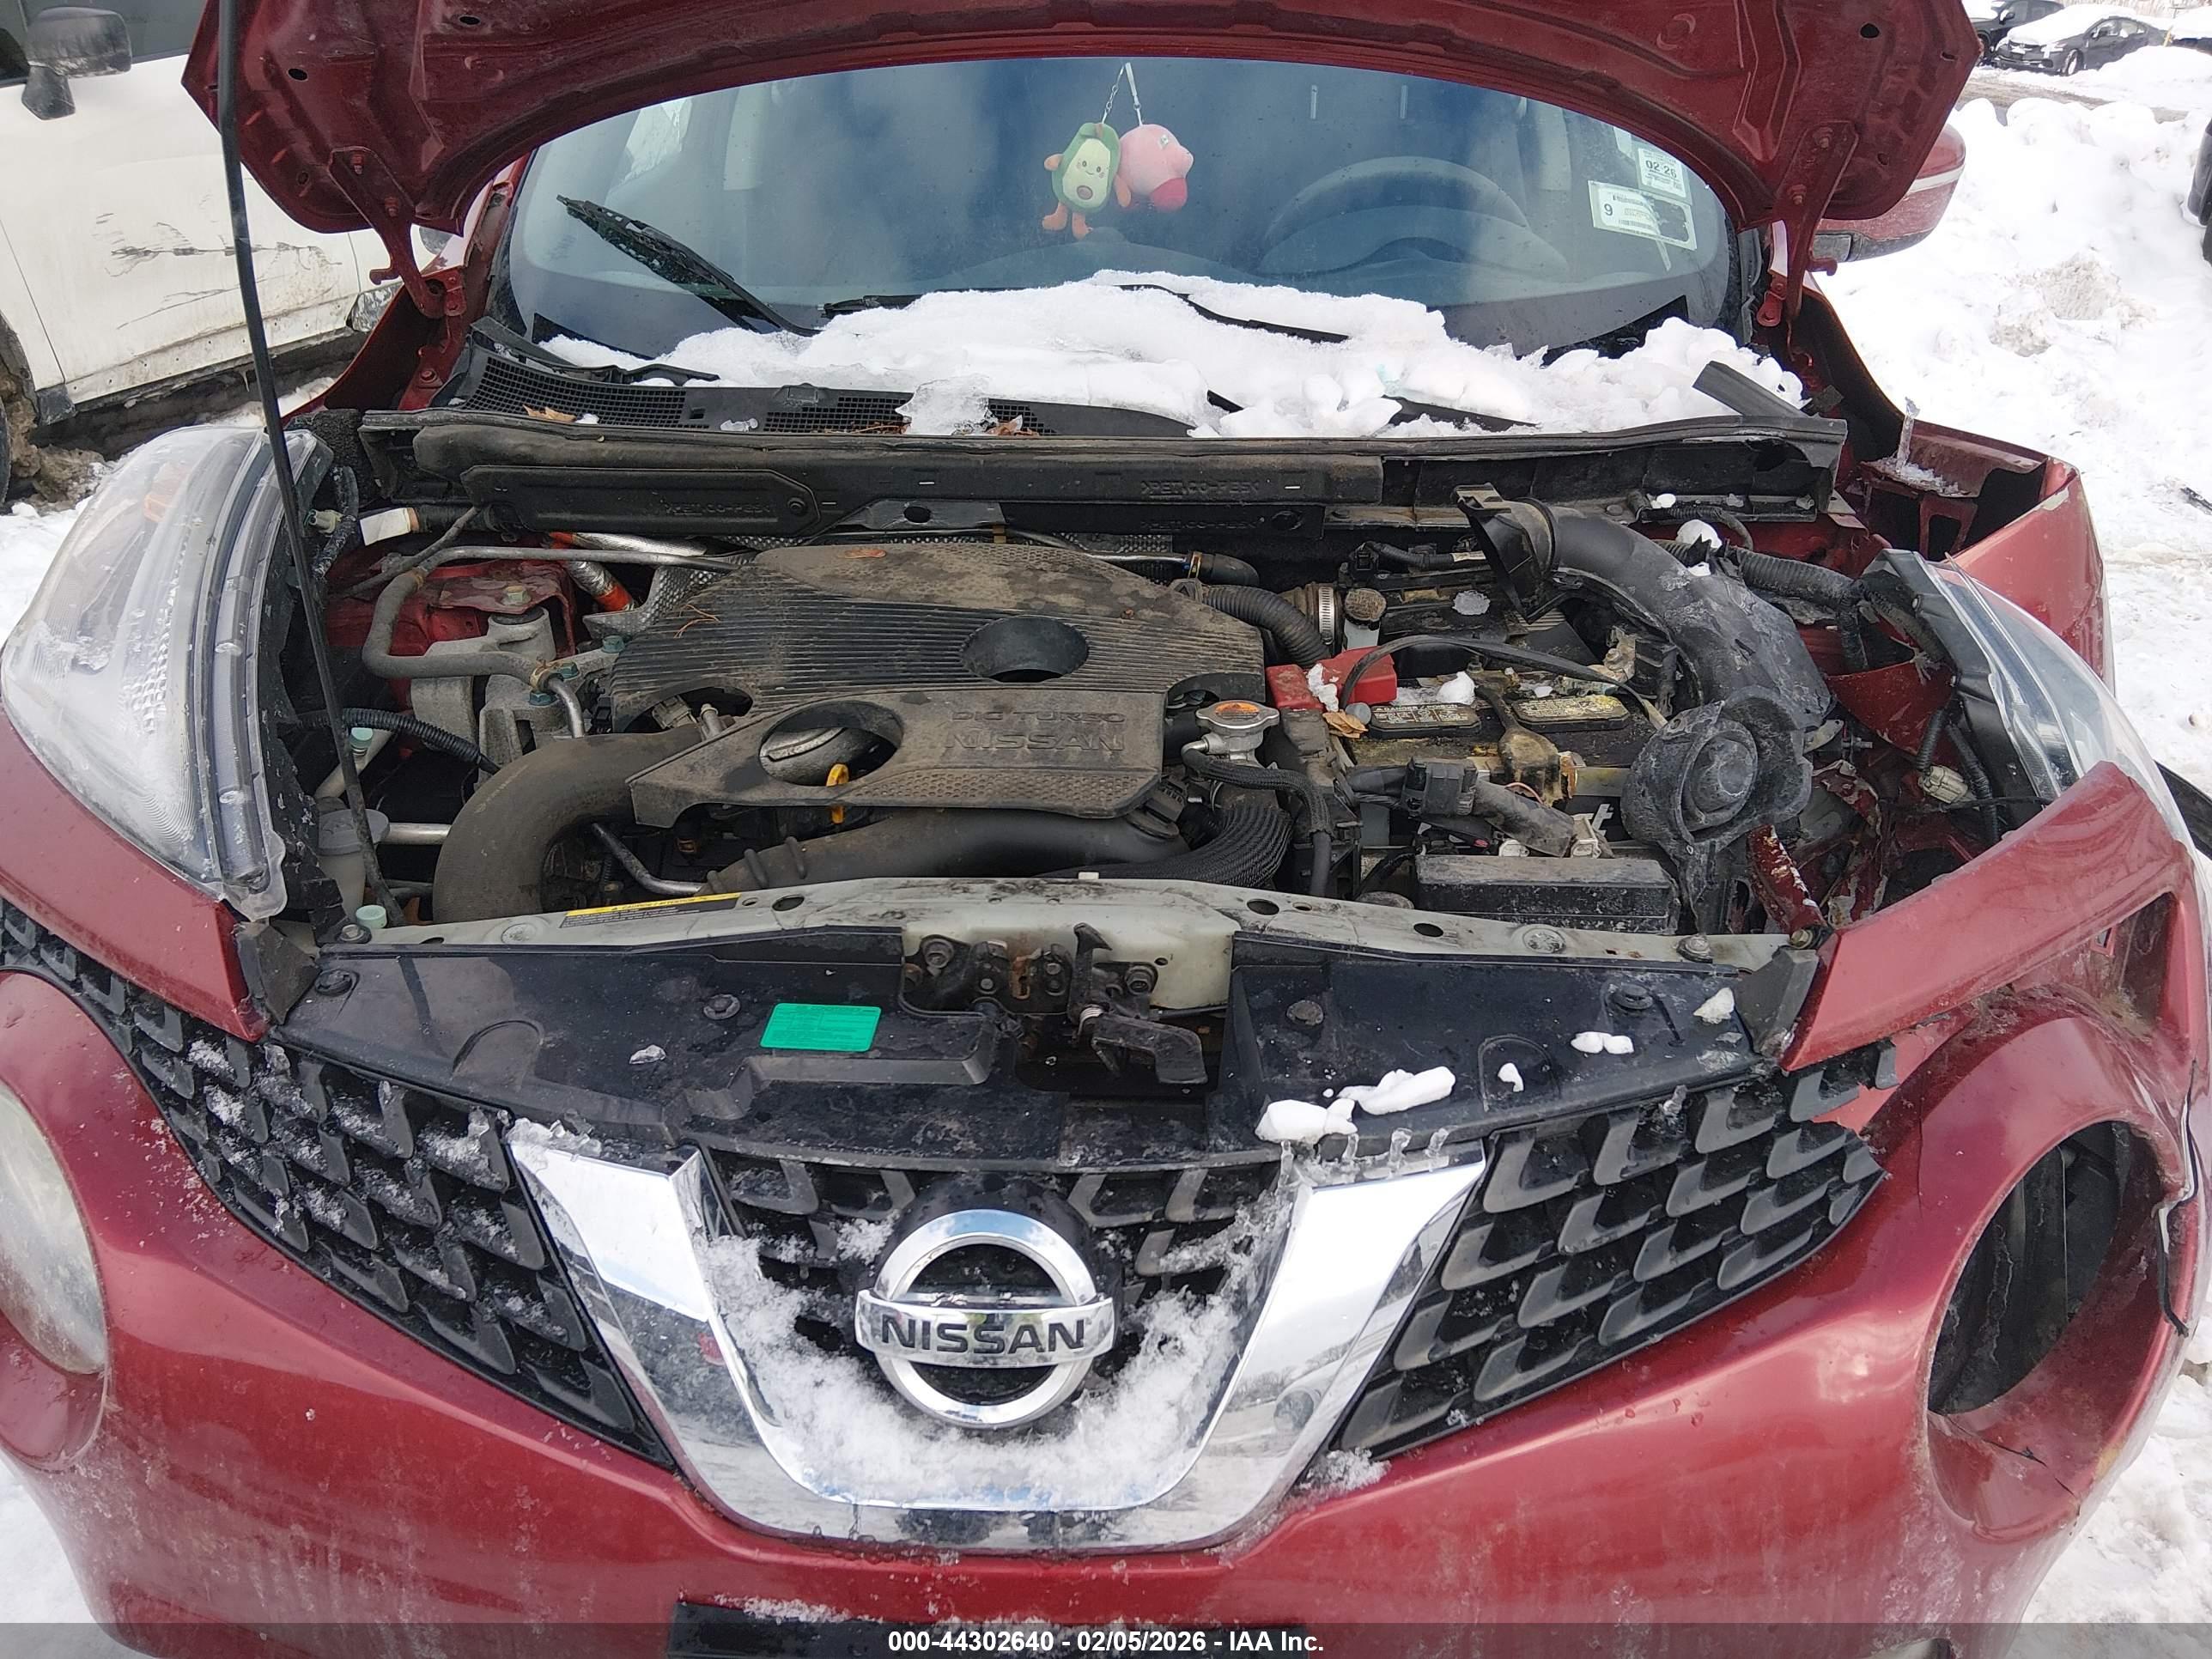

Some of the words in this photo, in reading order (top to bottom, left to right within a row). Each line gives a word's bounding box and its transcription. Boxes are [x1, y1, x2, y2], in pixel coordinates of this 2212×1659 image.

[1645, 160, 1660, 172] 02
[1604, 203, 1613, 216] 9
[945, 734, 1125, 751] NISSAN
[881, 1313, 1085, 1354] NISSAN
